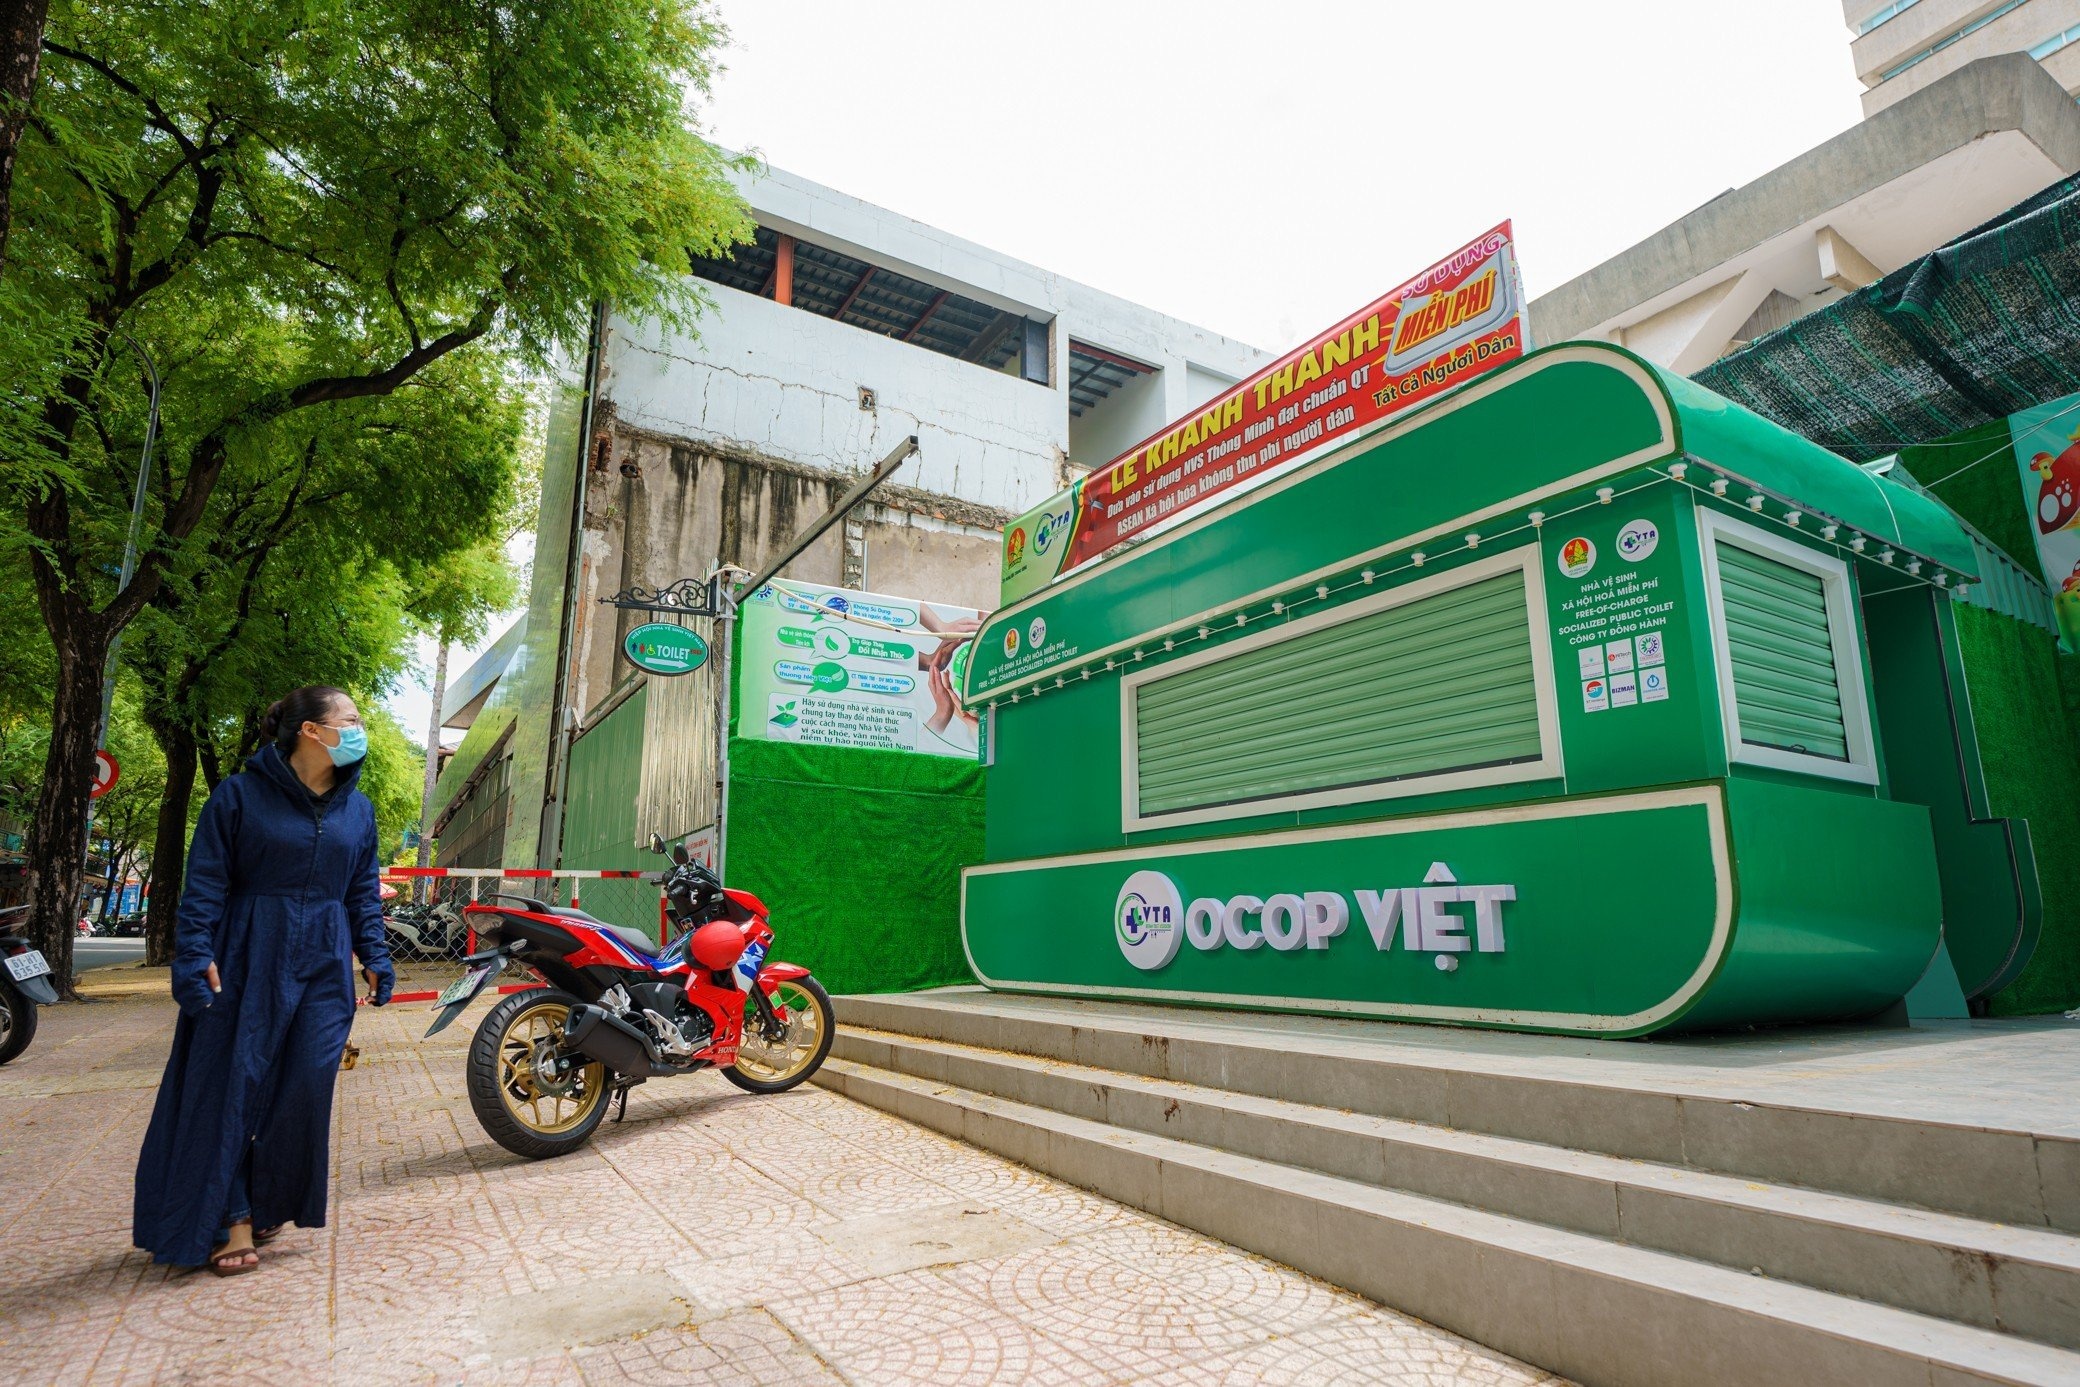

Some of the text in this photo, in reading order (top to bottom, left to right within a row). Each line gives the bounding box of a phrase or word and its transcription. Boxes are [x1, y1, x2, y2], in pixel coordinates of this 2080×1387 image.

[1433, 233, 1501, 284] DỤNG
[1449, 268, 1497, 329] PHÍ
[1372, 383, 1397, 408] Tất
[1400, 374, 1419, 395] Cả
[1477, 334, 1515, 360] Dân
[1125, 489, 1141, 509] vào
[1156, 467, 1182, 490] dụng
[1183, 452, 1204, 476] NVS
[1206, 438, 1241, 463] Thông
[1244, 415, 1275, 443] Minh
[1277, 402, 1300, 426] đạt
[1350, 364, 1370, 390] QT
[1117, 511, 1144, 536] ASEAN
[1159, 493, 1175, 513] hội
[1177, 484, 1197, 505] hóa
[1199, 464, 1234, 494] không
[1236, 454, 1257, 475] thu
[1260, 438, 1281, 460] phí
[1283, 418, 1324, 452] người
[1326, 405, 1355, 432] dân
[1051, 510, 1070, 530] VTA
[1636, 530, 1656, 541] VTA
[1580, 571, 1637, 593] NHÀ VỆ SINH
[1562, 577, 1659, 611] XÃ HỘI HOÁ MIỄN PHÍ
[1575, 594, 1649, 619] FREE-OF-CHARGE
[1558, 601, 1674, 636] SOCIALIZED PUBLIC TOILET
[1569, 617, 1667, 645] CÔNG TY ĐỒNG HÀNH
[657, 645, 690, 660] TOILET
[1056, 639, 1066, 651] PHÍ
[999, 670, 1017, 682] CHARGE
[1017, 660, 1044, 675] SOCIALIZED
[1044, 652, 1061, 665] PUBLIC
[1061, 646, 1079, 658] TOILET
[1611, 685, 1635, 694] BIZMAN
[801, 709, 823, 718] chung
[824, 710, 836, 719] tay
[837, 711, 852, 720] thay
[827, 700, 845, 711] dụng
[871, 705, 885, 714] sinh
[883, 726, 899, 734] Sinh
[895, 743, 914, 751] Nam
[1143, 906, 1171, 923] VTA
[1185, 861, 1517, 972] OCOP VIỆT
